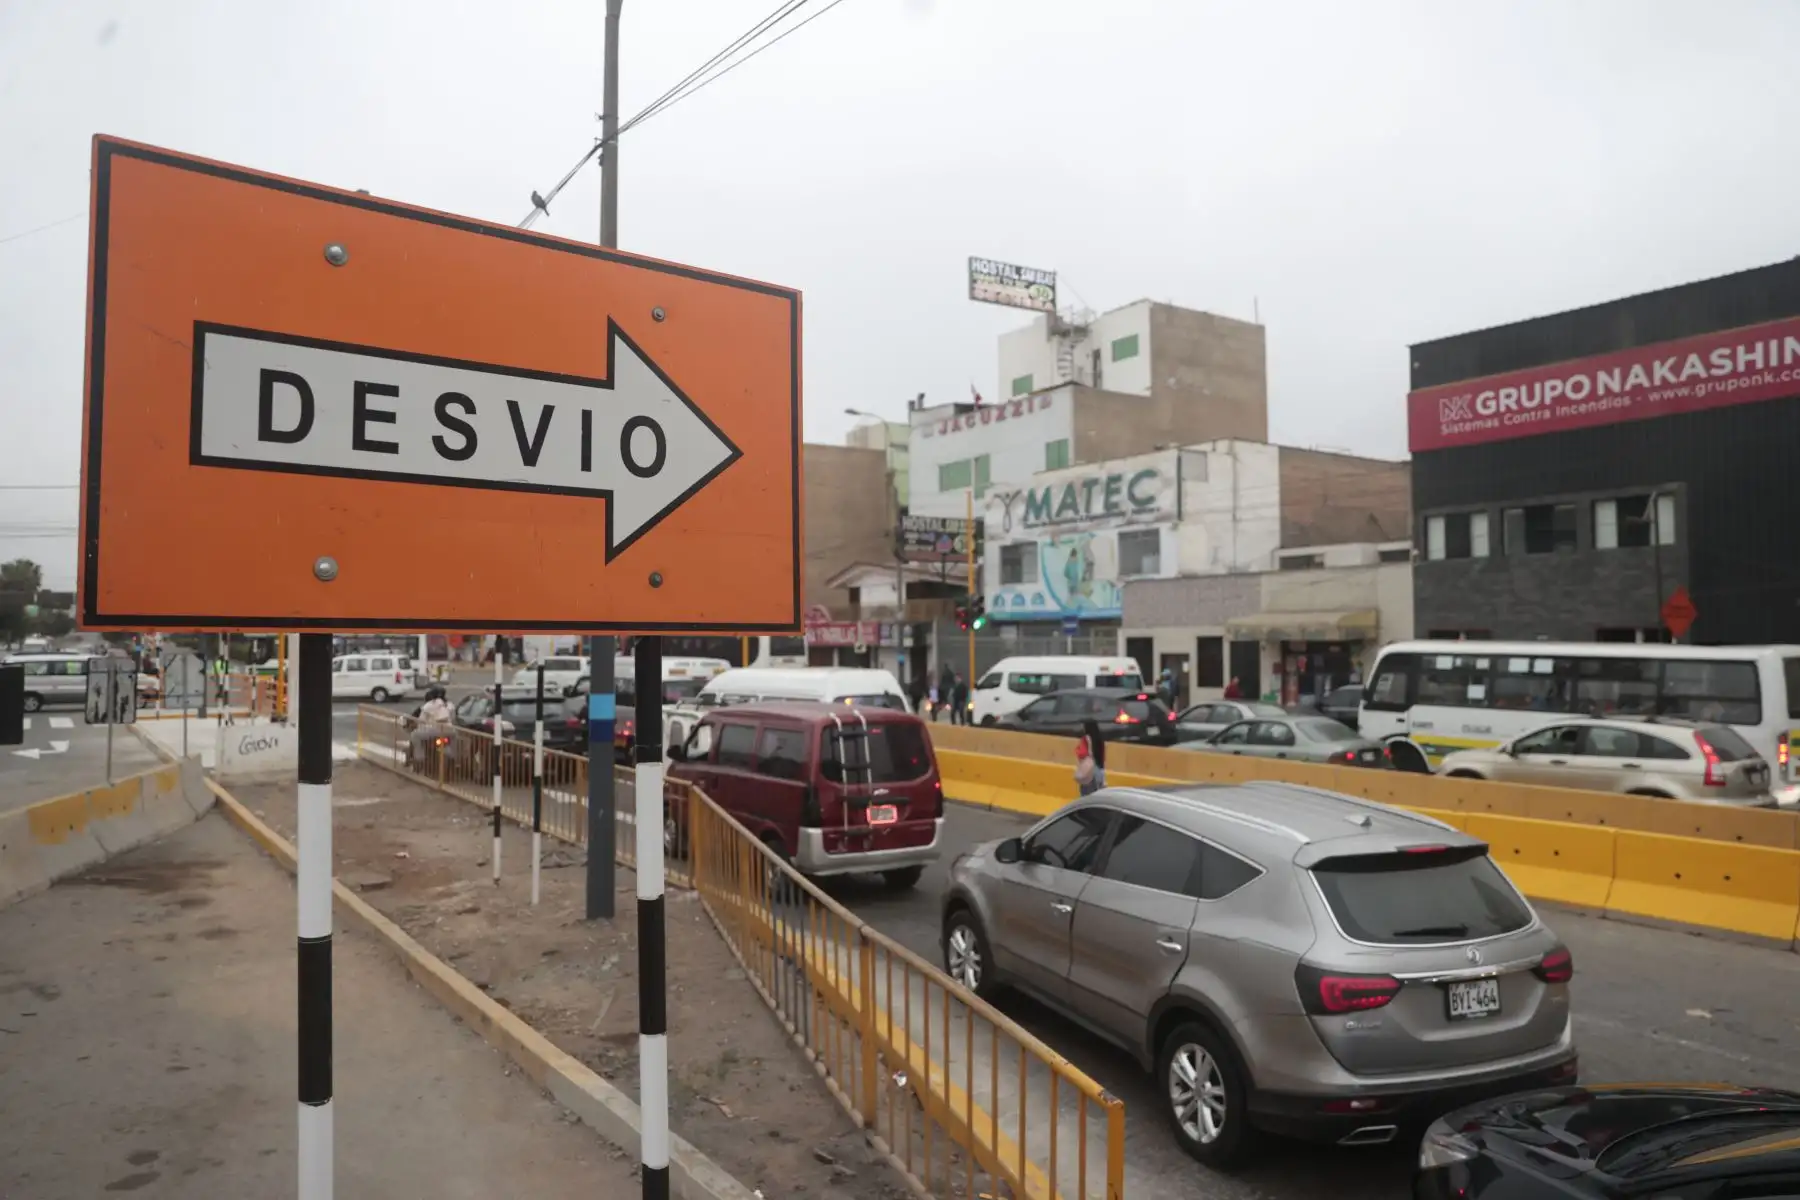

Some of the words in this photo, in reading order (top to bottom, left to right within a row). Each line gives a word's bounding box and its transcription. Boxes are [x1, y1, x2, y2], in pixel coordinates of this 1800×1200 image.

[1440, 417, 1499, 435] Sistemas
[1503, 408, 1551, 425] Contra
[1555, 394, 1632, 416] Incendios
[1475, 374, 1591, 416] GRUPO
[257, 368, 668, 479] DESVIO
[1023, 468, 1159, 522] MATEC
